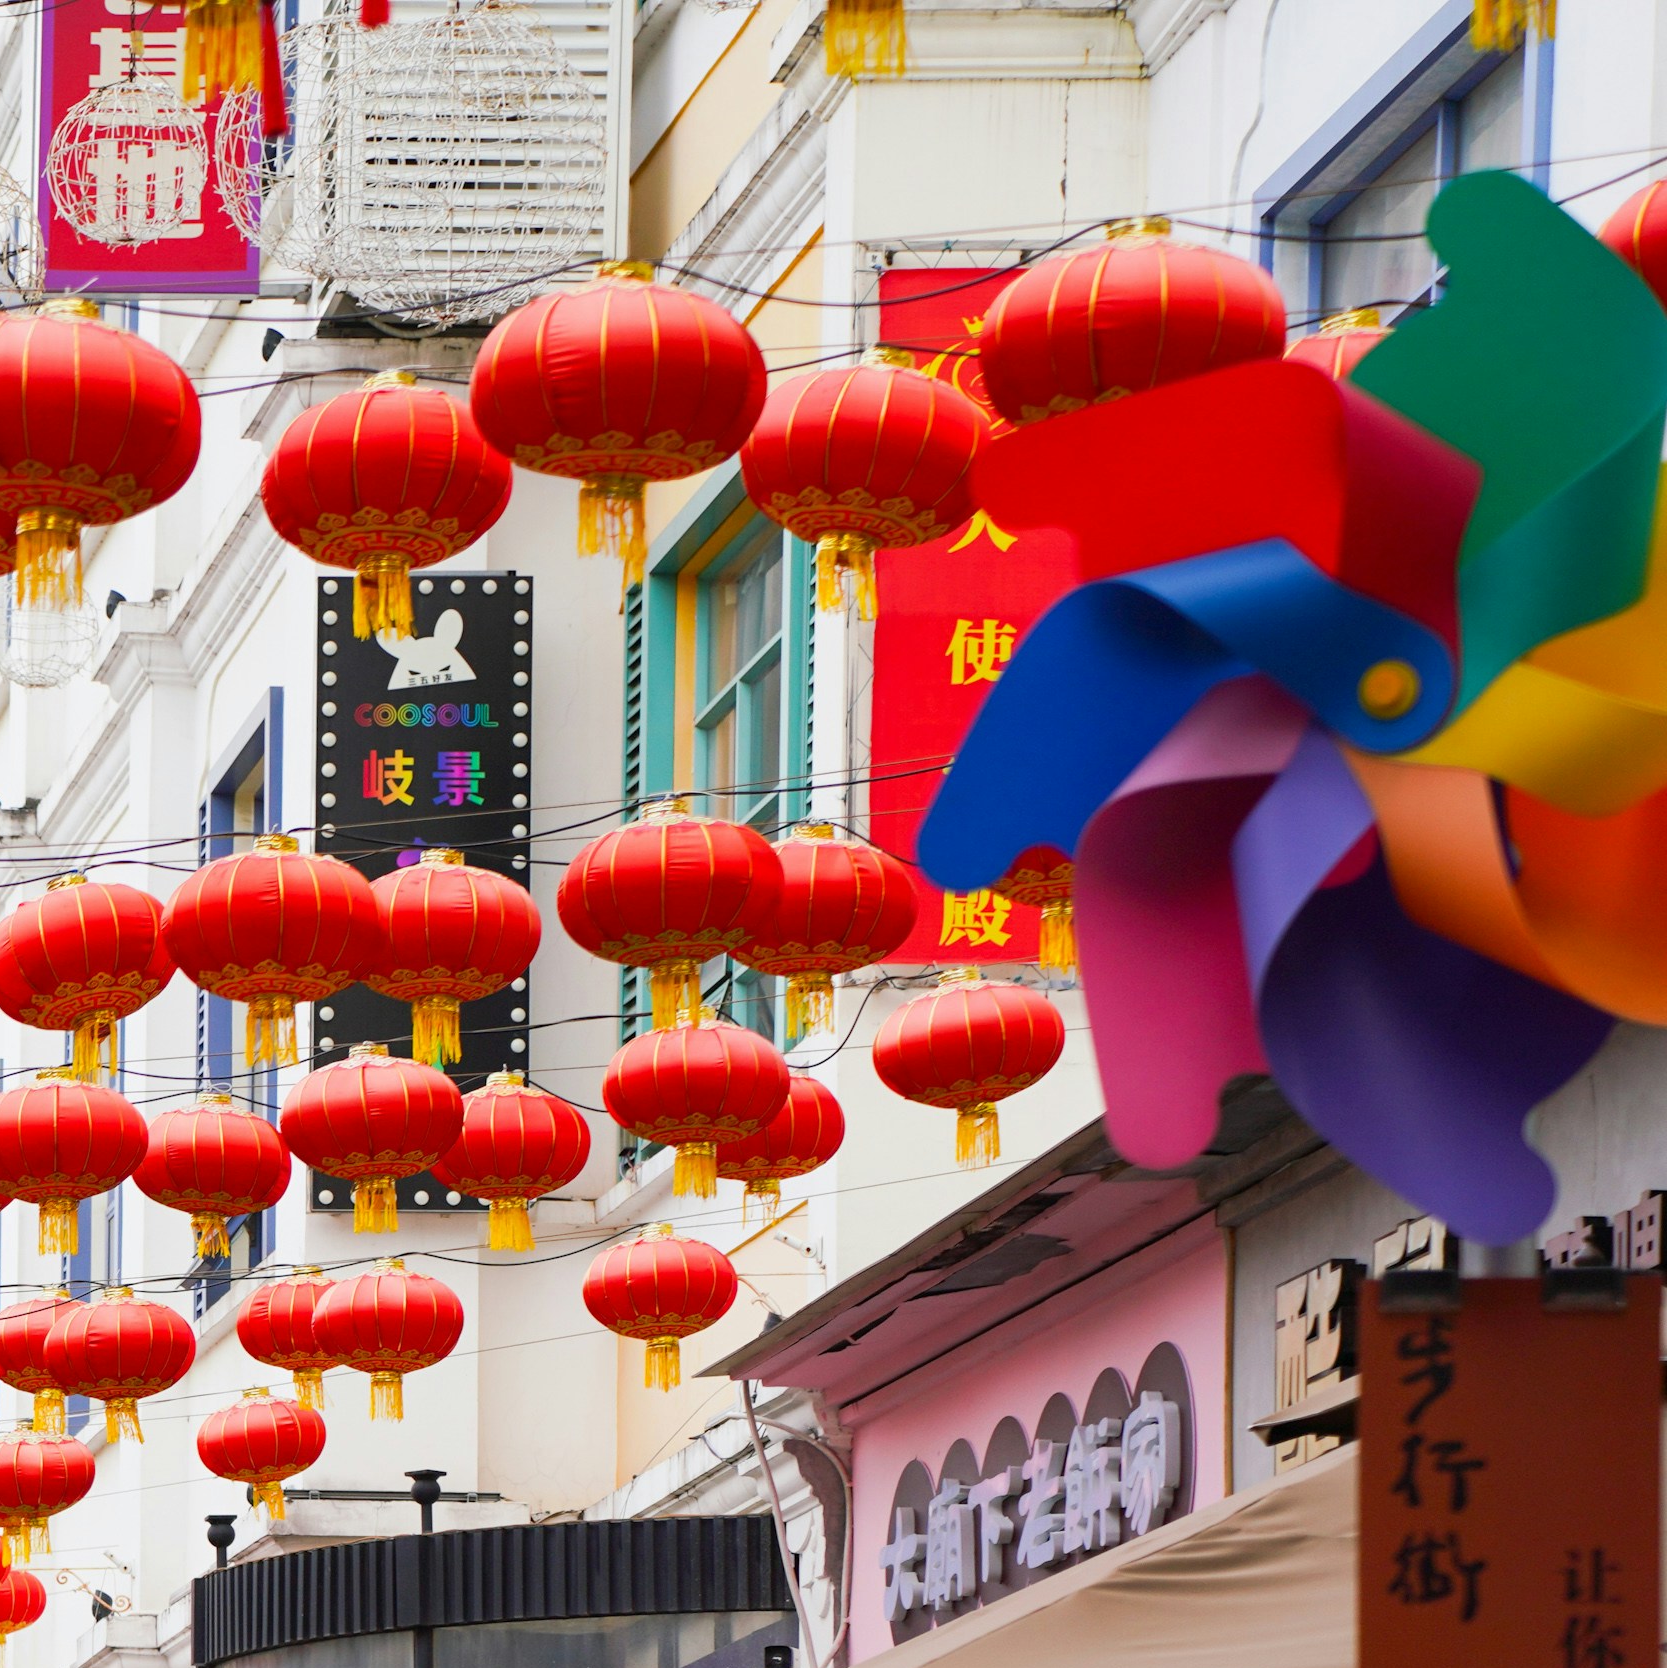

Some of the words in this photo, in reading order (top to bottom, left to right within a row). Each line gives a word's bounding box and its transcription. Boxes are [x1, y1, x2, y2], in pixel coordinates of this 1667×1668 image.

[408, 673, 454, 687] 三五好友
[353, 702, 500, 728] COOSOUL
[362, 749, 487, 807] 岐景
